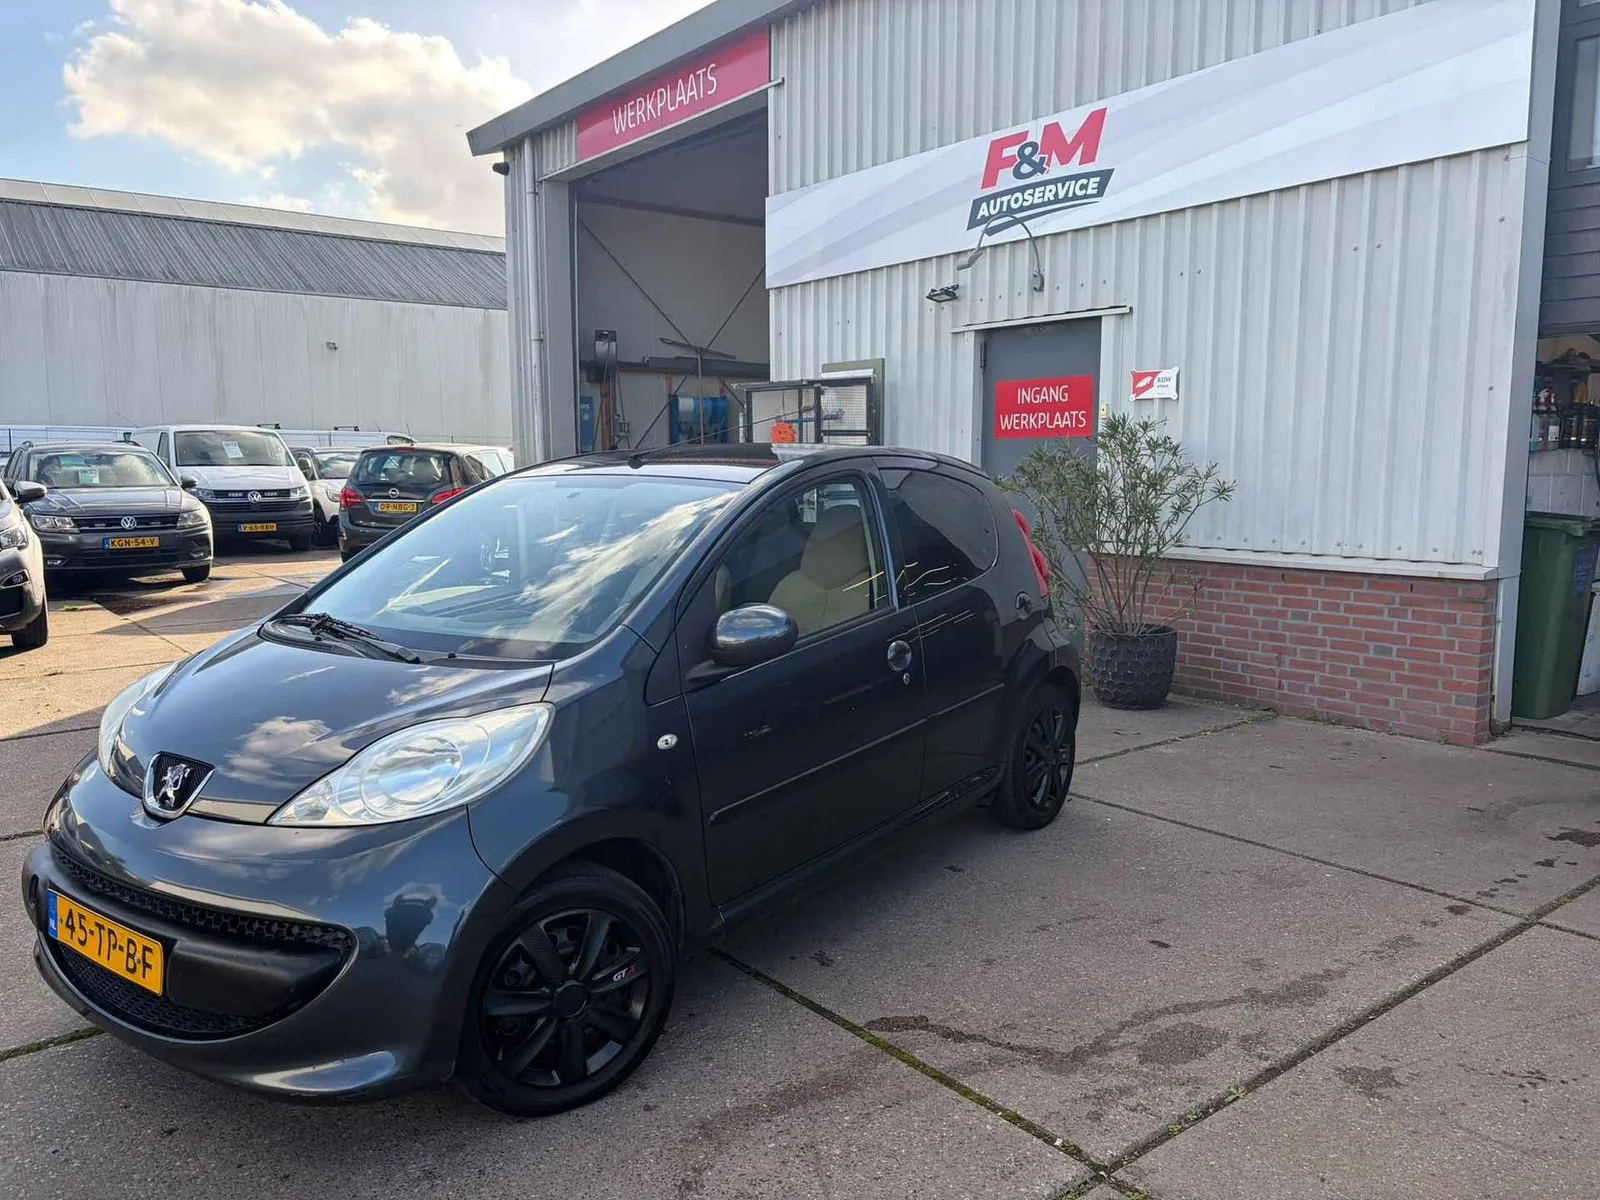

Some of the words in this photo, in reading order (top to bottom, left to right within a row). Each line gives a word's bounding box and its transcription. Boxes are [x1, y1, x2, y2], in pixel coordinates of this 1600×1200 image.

[612, 63, 717, 135] WERKPLAATS
[981, 107, 1107, 190] F&M
[976, 176, 1101, 220] AUTOSERVICE
[1017, 385, 1069, 404] INGANG
[999, 411, 1087, 430] WERKPLAATS
[110, 538, 155, 548] KGN-54-V
[65, 908, 153, 979] 45-TP-BF
